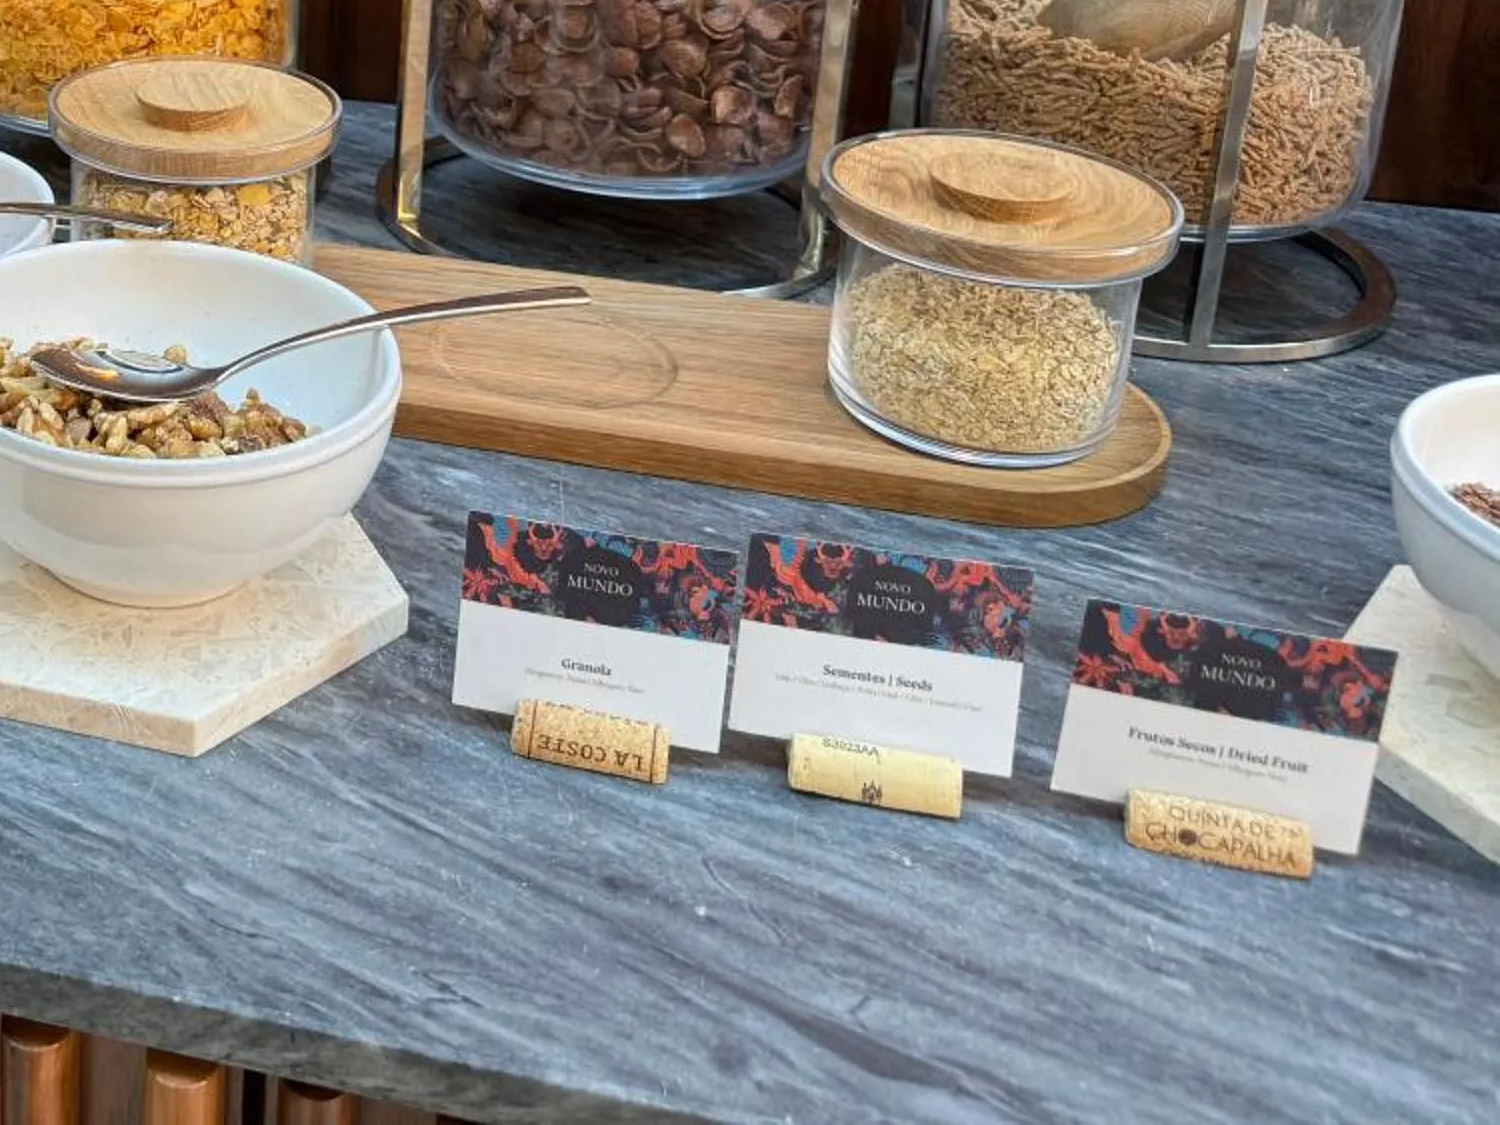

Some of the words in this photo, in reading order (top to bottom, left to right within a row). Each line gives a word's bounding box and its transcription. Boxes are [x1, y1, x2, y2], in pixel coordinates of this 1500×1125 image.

[583, 562, 621, 577] NOVO
[566, 573, 635, 598] MUNDO
[874, 579, 912, 595] NOVO
[856, 591, 926, 616] MUNDO
[560, 658, 613, 677] Granola
[1221, 651, 1263, 670] NOVO
[822, 663, 886, 687] Sementes
[895, 675, 934, 693] Seeds
[1199, 664, 1277, 692] MUNDO
[536, 732, 608, 764] COSTE
[615, 748, 646, 772] LA
[1128, 725, 1176, 749] Frutos
[1176, 735, 1217, 757] Secos
[1227, 745, 1270, 767] Dried
[1270, 753, 1311, 774] Fruit
